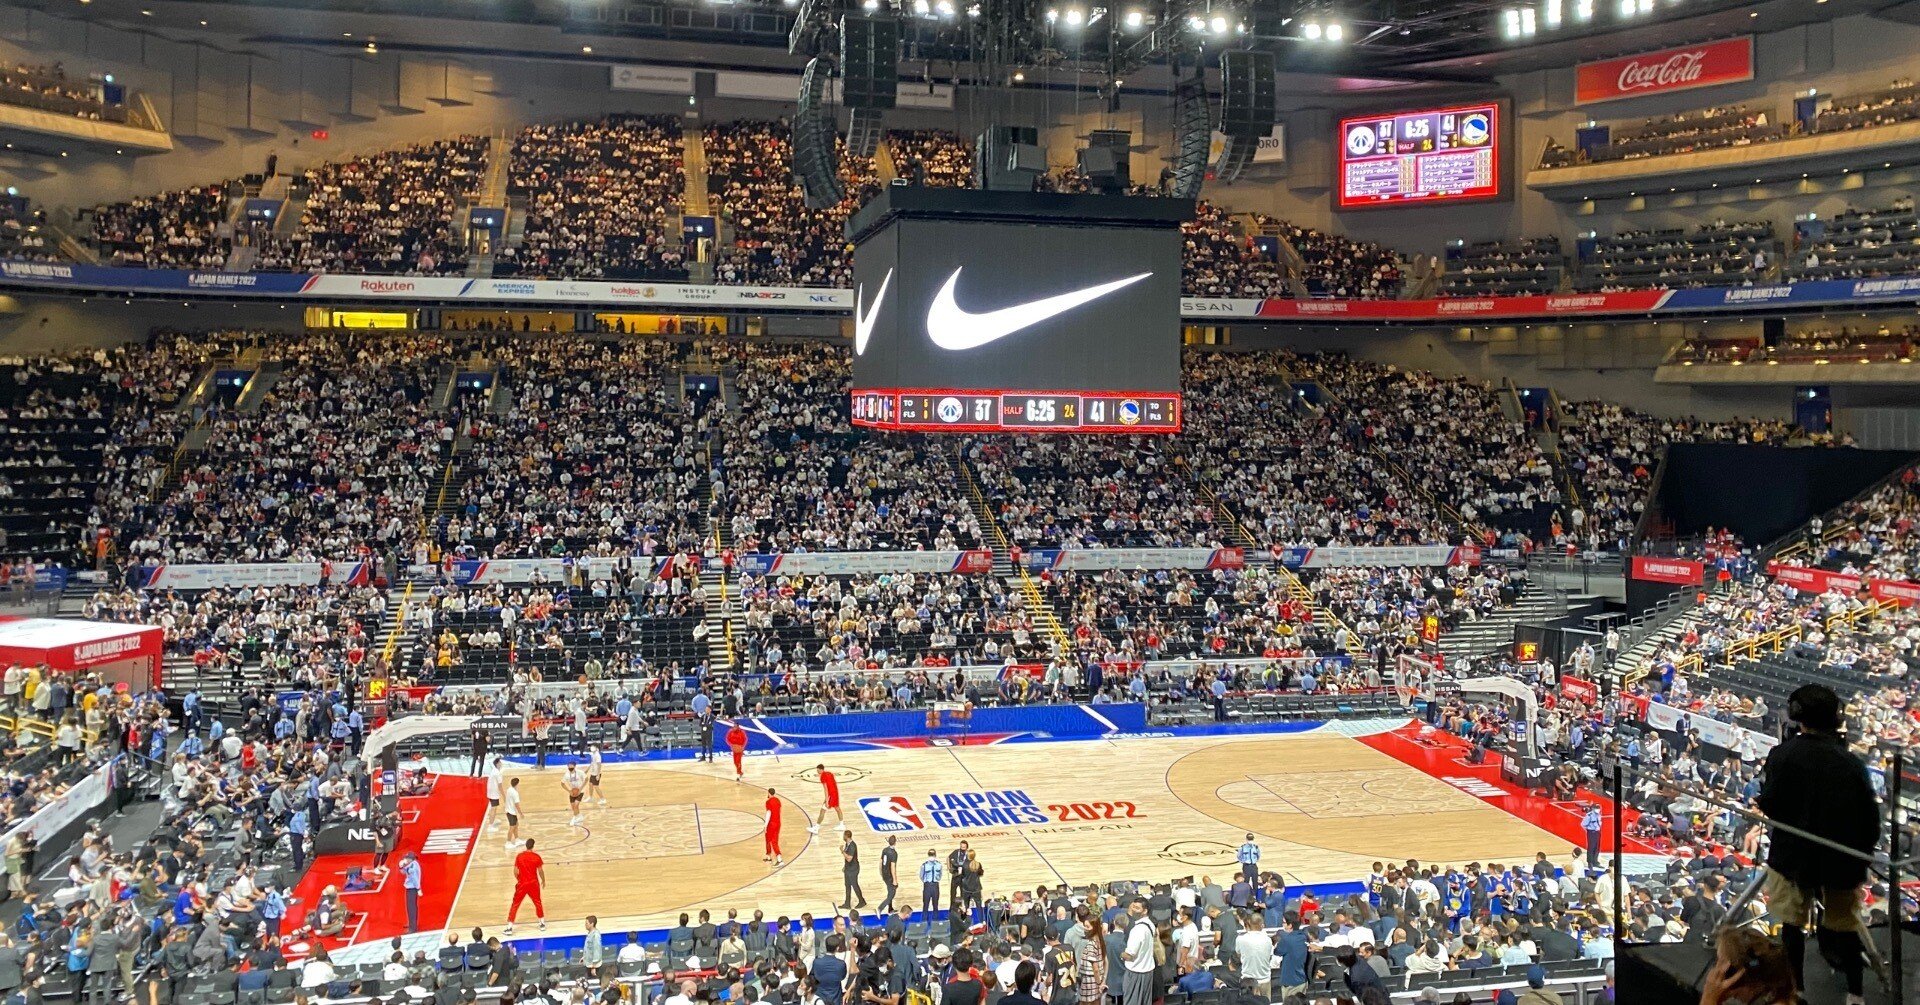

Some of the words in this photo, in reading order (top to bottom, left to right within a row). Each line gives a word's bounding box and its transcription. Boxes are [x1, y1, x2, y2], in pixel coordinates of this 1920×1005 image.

[1618, 50, 1707, 91] Coca-Cola
[1258, 138, 1278, 148] ORO
[195, 274, 216, 284] JAPAN
[216, 275, 238, 284] GAMES
[239, 276, 256, 286] 2022
[361, 280, 414, 291] Rakuten
[1731, 290, 1752, 300] JAPAN
[1752, 289, 1773, 298] GAMES
[1774, 288, 1792, 298] 2022
[1182, 303, 1233, 311] SSAN
[1443, 302, 1460, 311] JAPAN
[1478, 301, 1494, 310] 2022
[1554, 299, 1570, 308] JAPAN
[1589, 297, 1606, 306] 2022
[974, 399, 992, 421] 37
[1004, 406, 1024, 414] HALF
[1026, 400, 1056, 422] 6:25
[1064, 404, 1074, 418] 24
[1090, 400, 1104, 422] 41
[1649, 564, 1662, 572] JAPAN
[1663, 564, 1678, 574] GAMES
[1678, 566, 1690, 576] 2022
[80, 642, 102, 659] JAPAN
[102, 639, 123, 655] GAMES
[124, 636, 141, 650] 2022
[694, 750, 774, 758] Rakten
[926, 790, 1038, 811] JAPAN
[930, 806, 1049, 829] GAMES
[1048, 801, 1147, 822] 2022
[878, 823, 906, 831] NBA
[1032, 824, 1132, 834] NISSAN
[348, 828, 376, 840] NE
[1157, 850, 1238, 858] NISSA
[1372, 884, 1382, 894] 30
